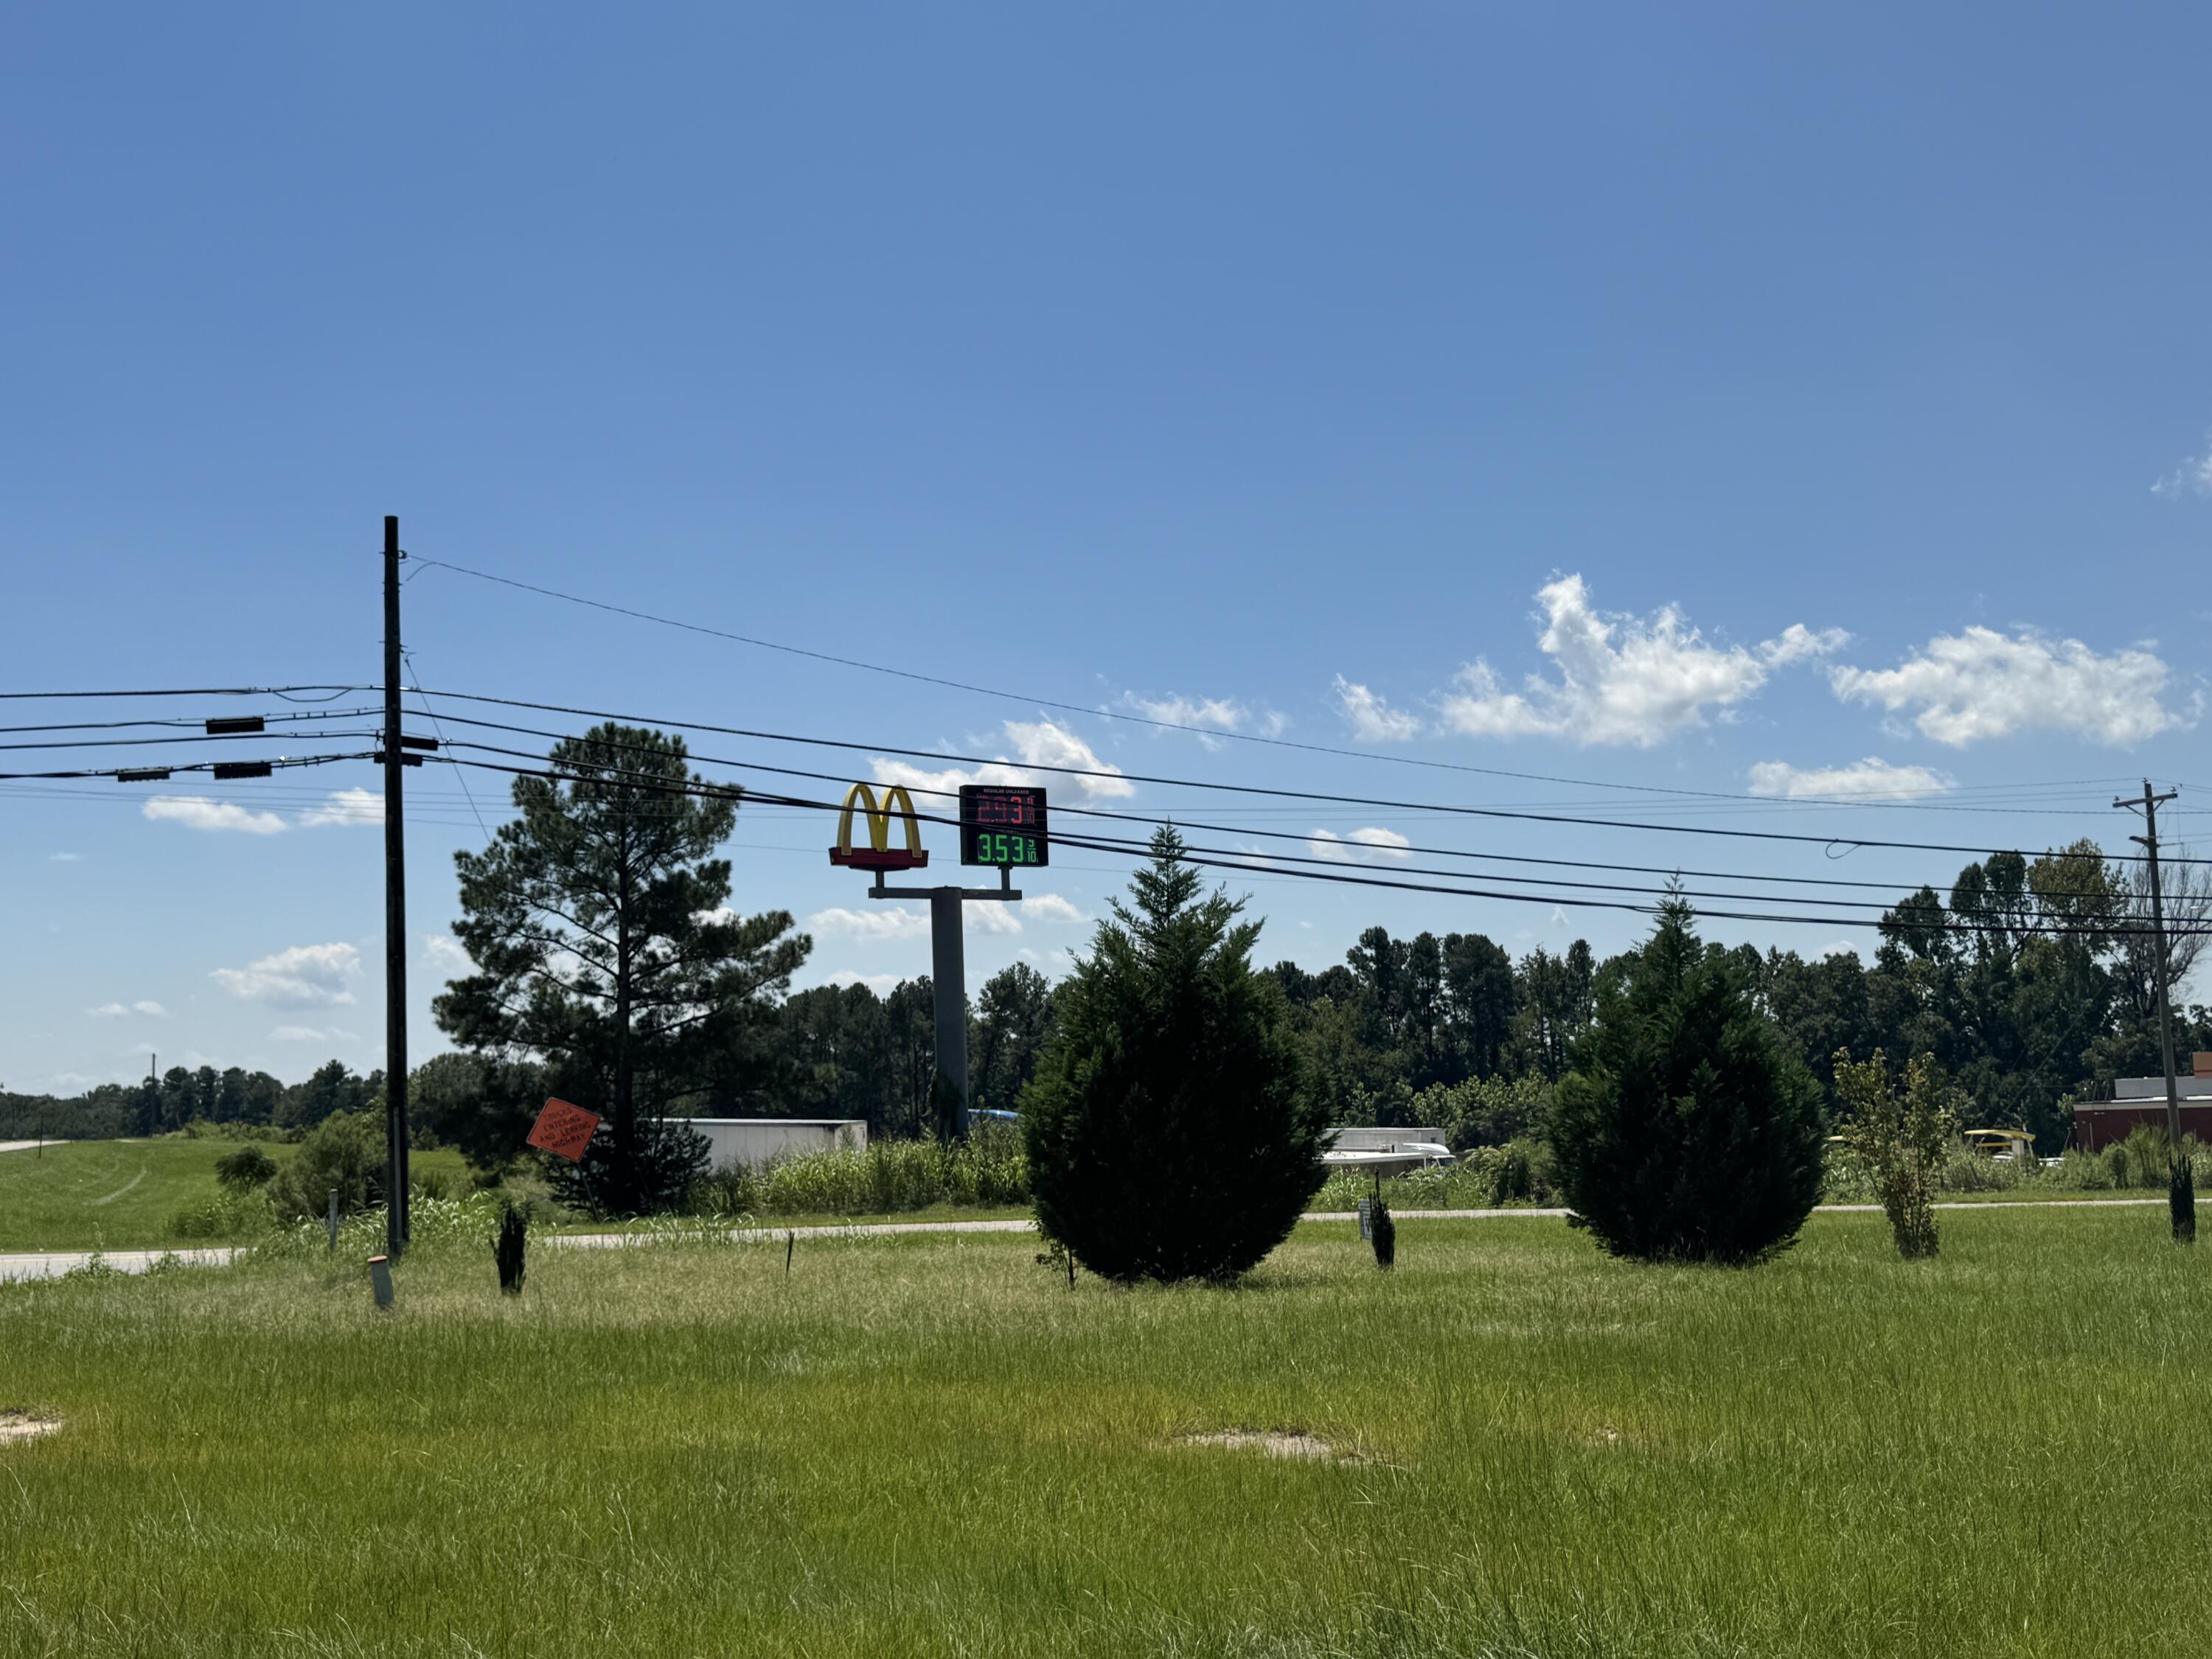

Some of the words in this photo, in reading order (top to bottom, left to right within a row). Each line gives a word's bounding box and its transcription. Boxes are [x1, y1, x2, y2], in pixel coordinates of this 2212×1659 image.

[978, 834, 1024, 863] 3.53
[540, 1133, 555, 1143] AND
[560, 1121, 591, 1136] LEAVING
[543, 1113, 581, 1131] ENTERING
[552, 1132, 585, 1150] HIGHWAY
